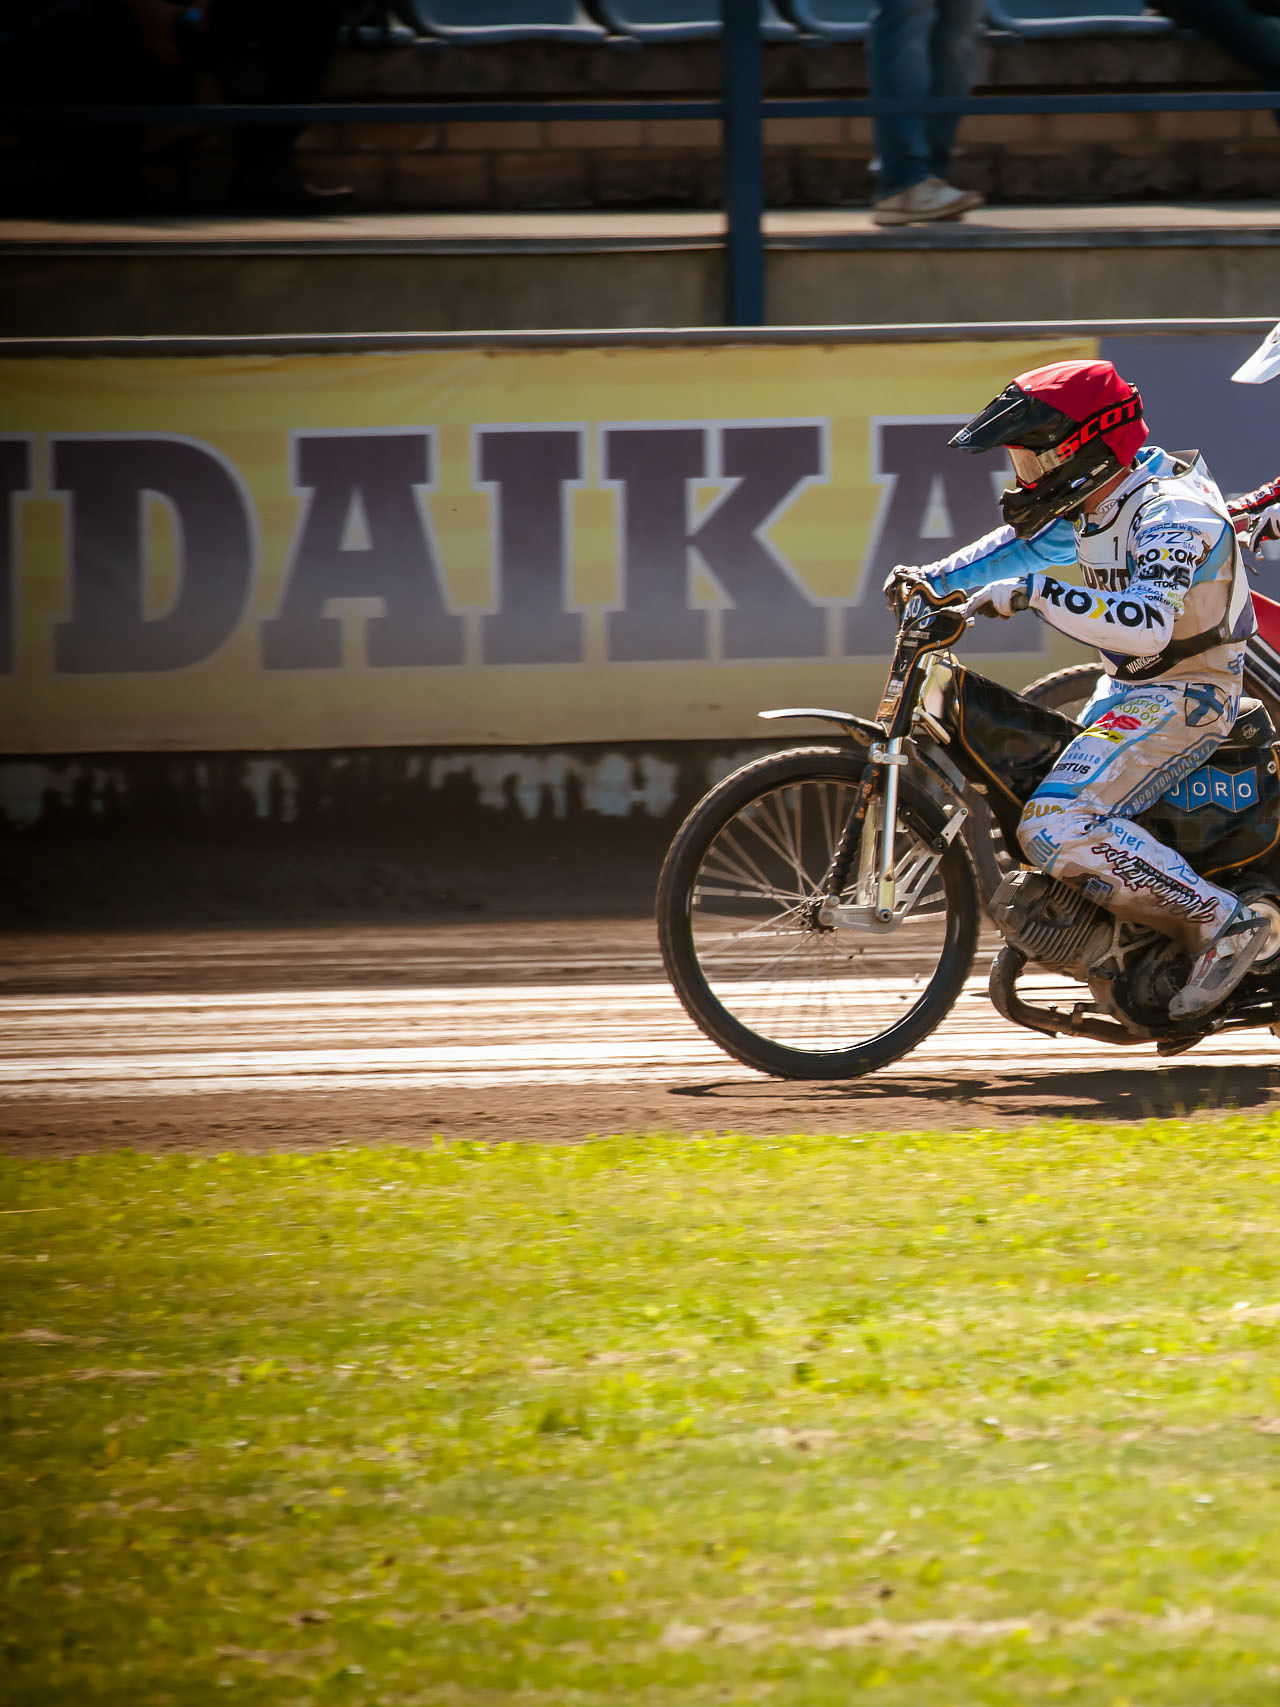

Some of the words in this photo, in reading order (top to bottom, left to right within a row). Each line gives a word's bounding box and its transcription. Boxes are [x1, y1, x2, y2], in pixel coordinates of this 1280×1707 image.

[0, 419, 1043, 676] DAIKA
[1112, 536, 1119, 561] 1
[1041, 576, 1166, 629] ROXON
[1170, 777, 1253, 799] JORO
